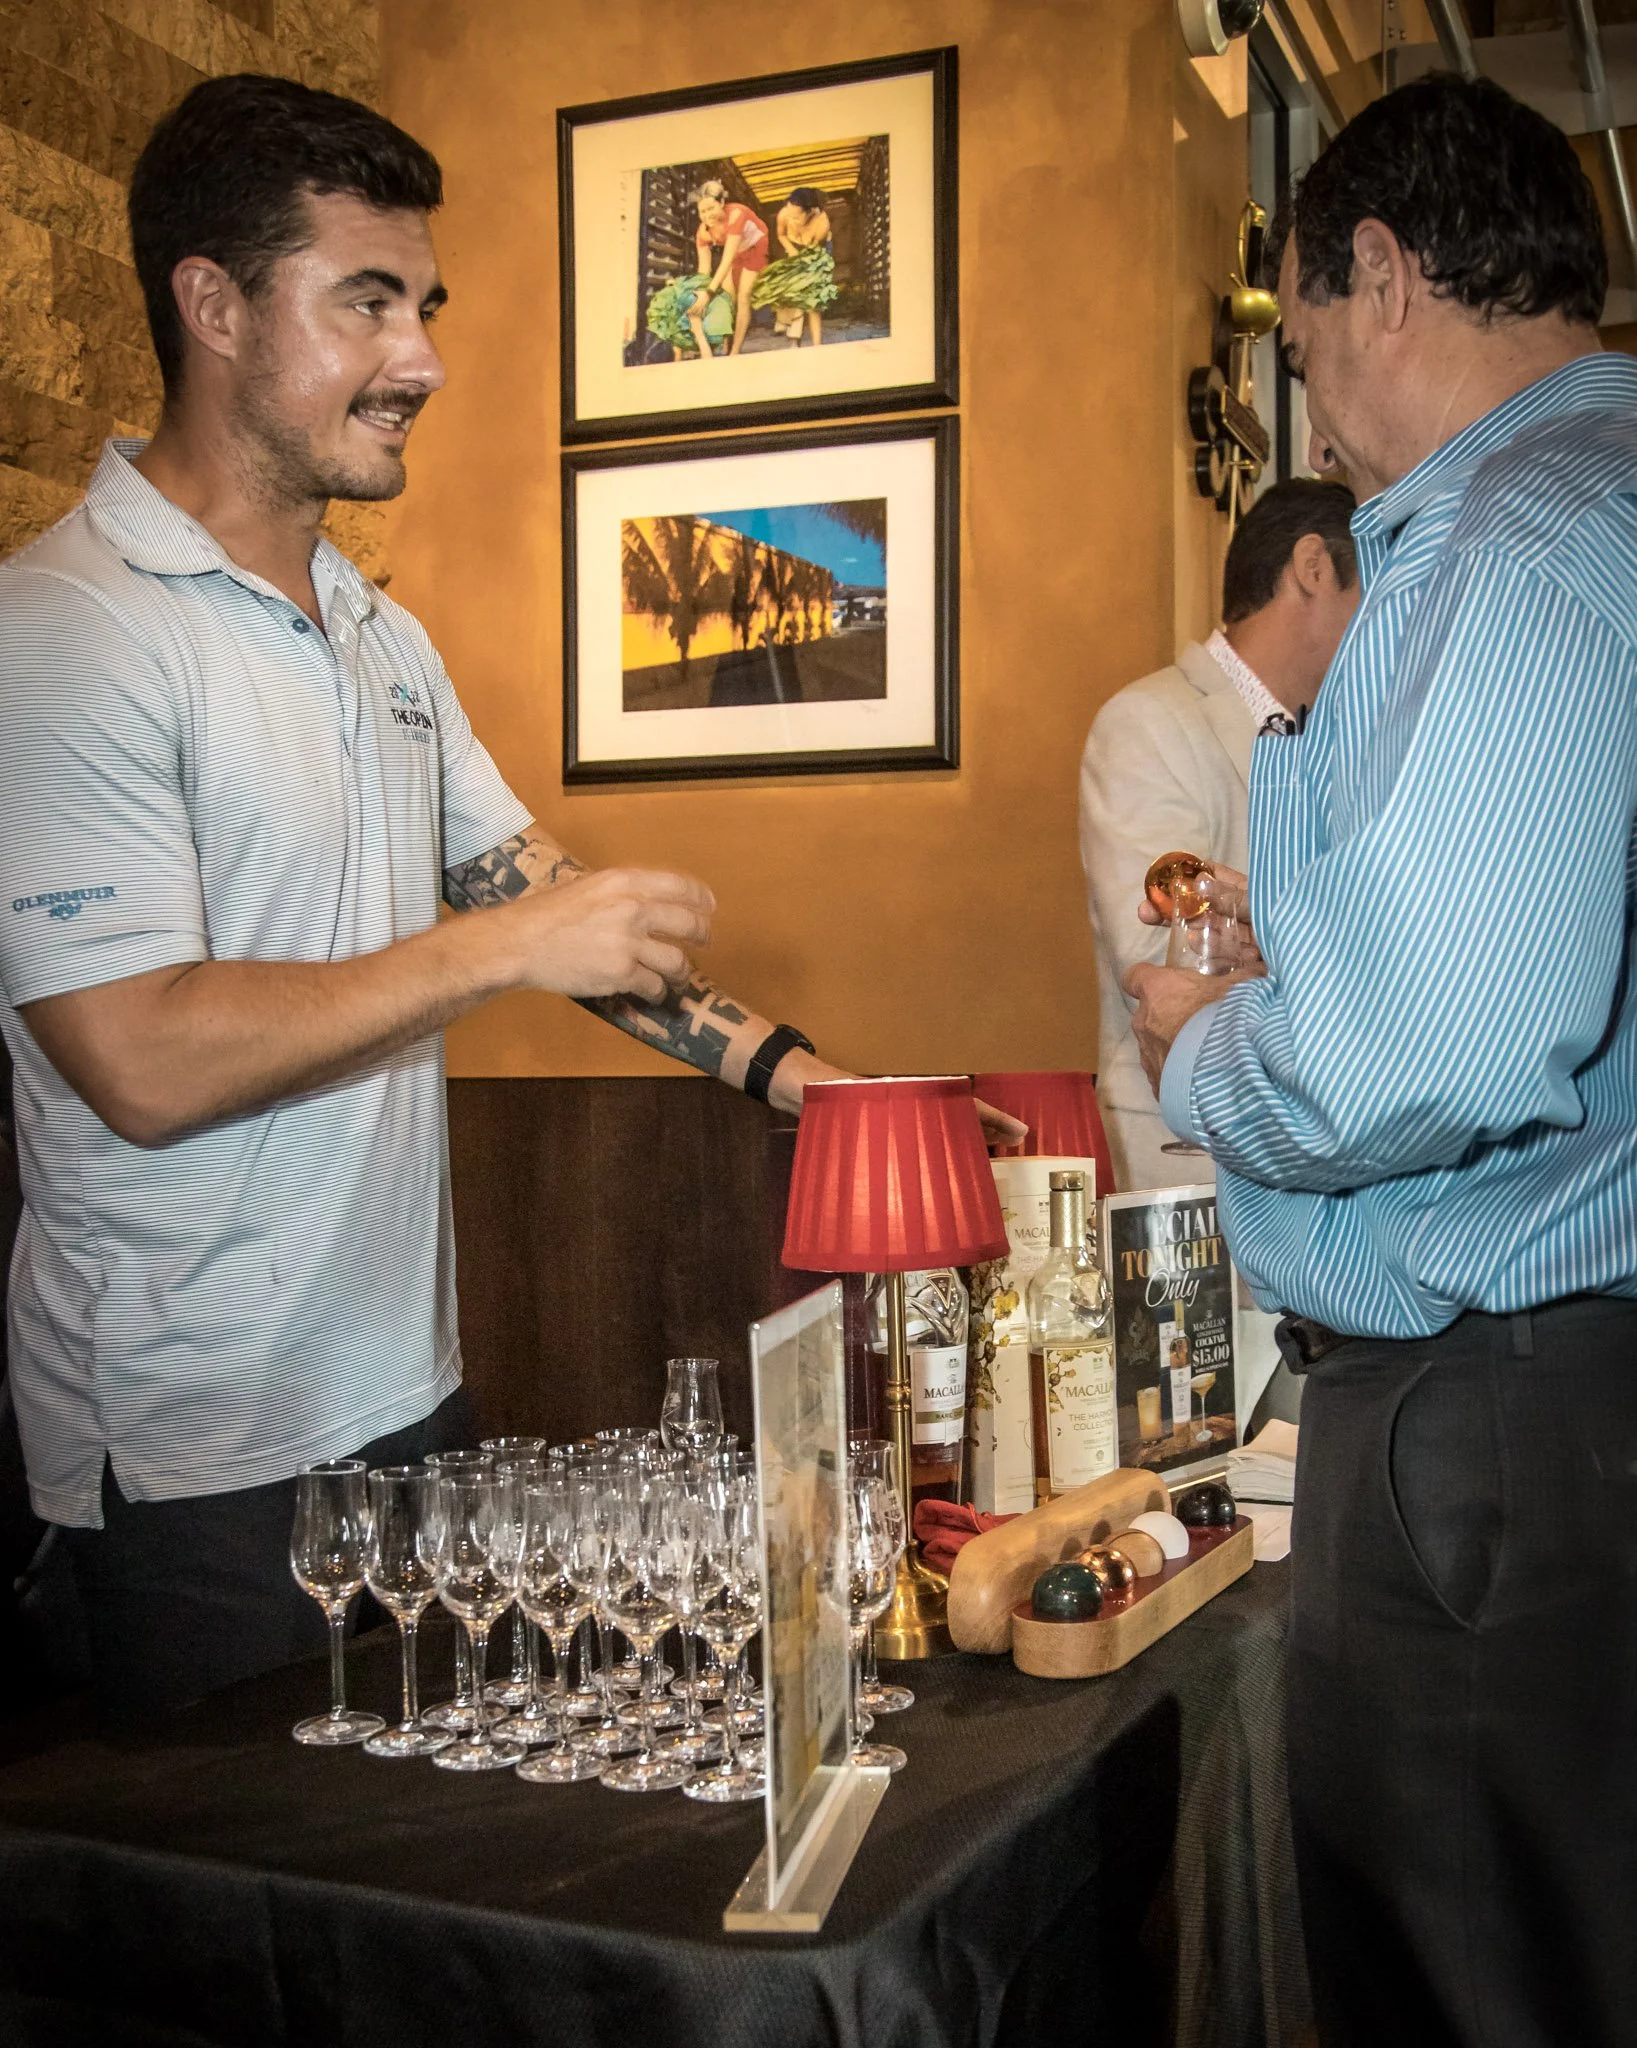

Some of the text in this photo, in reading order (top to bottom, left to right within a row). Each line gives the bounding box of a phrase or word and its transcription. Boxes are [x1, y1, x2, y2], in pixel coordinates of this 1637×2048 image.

[391, 708, 433, 729] THE OPEN
[1014, 1227, 1050, 1239] MACAL
[1138, 1206, 1221, 1245] ECIAL
[1121, 1237, 1222, 1281] TONIGHT
[1145, 1267, 1200, 1307] Only
[1193, 1317, 1226, 1331] MACALLAN
[1195, 1333, 1226, 1348] COCKTAIL
[1192, 1343, 1230, 1367] $15.00
[1069, 1413, 1087, 1422] THE
